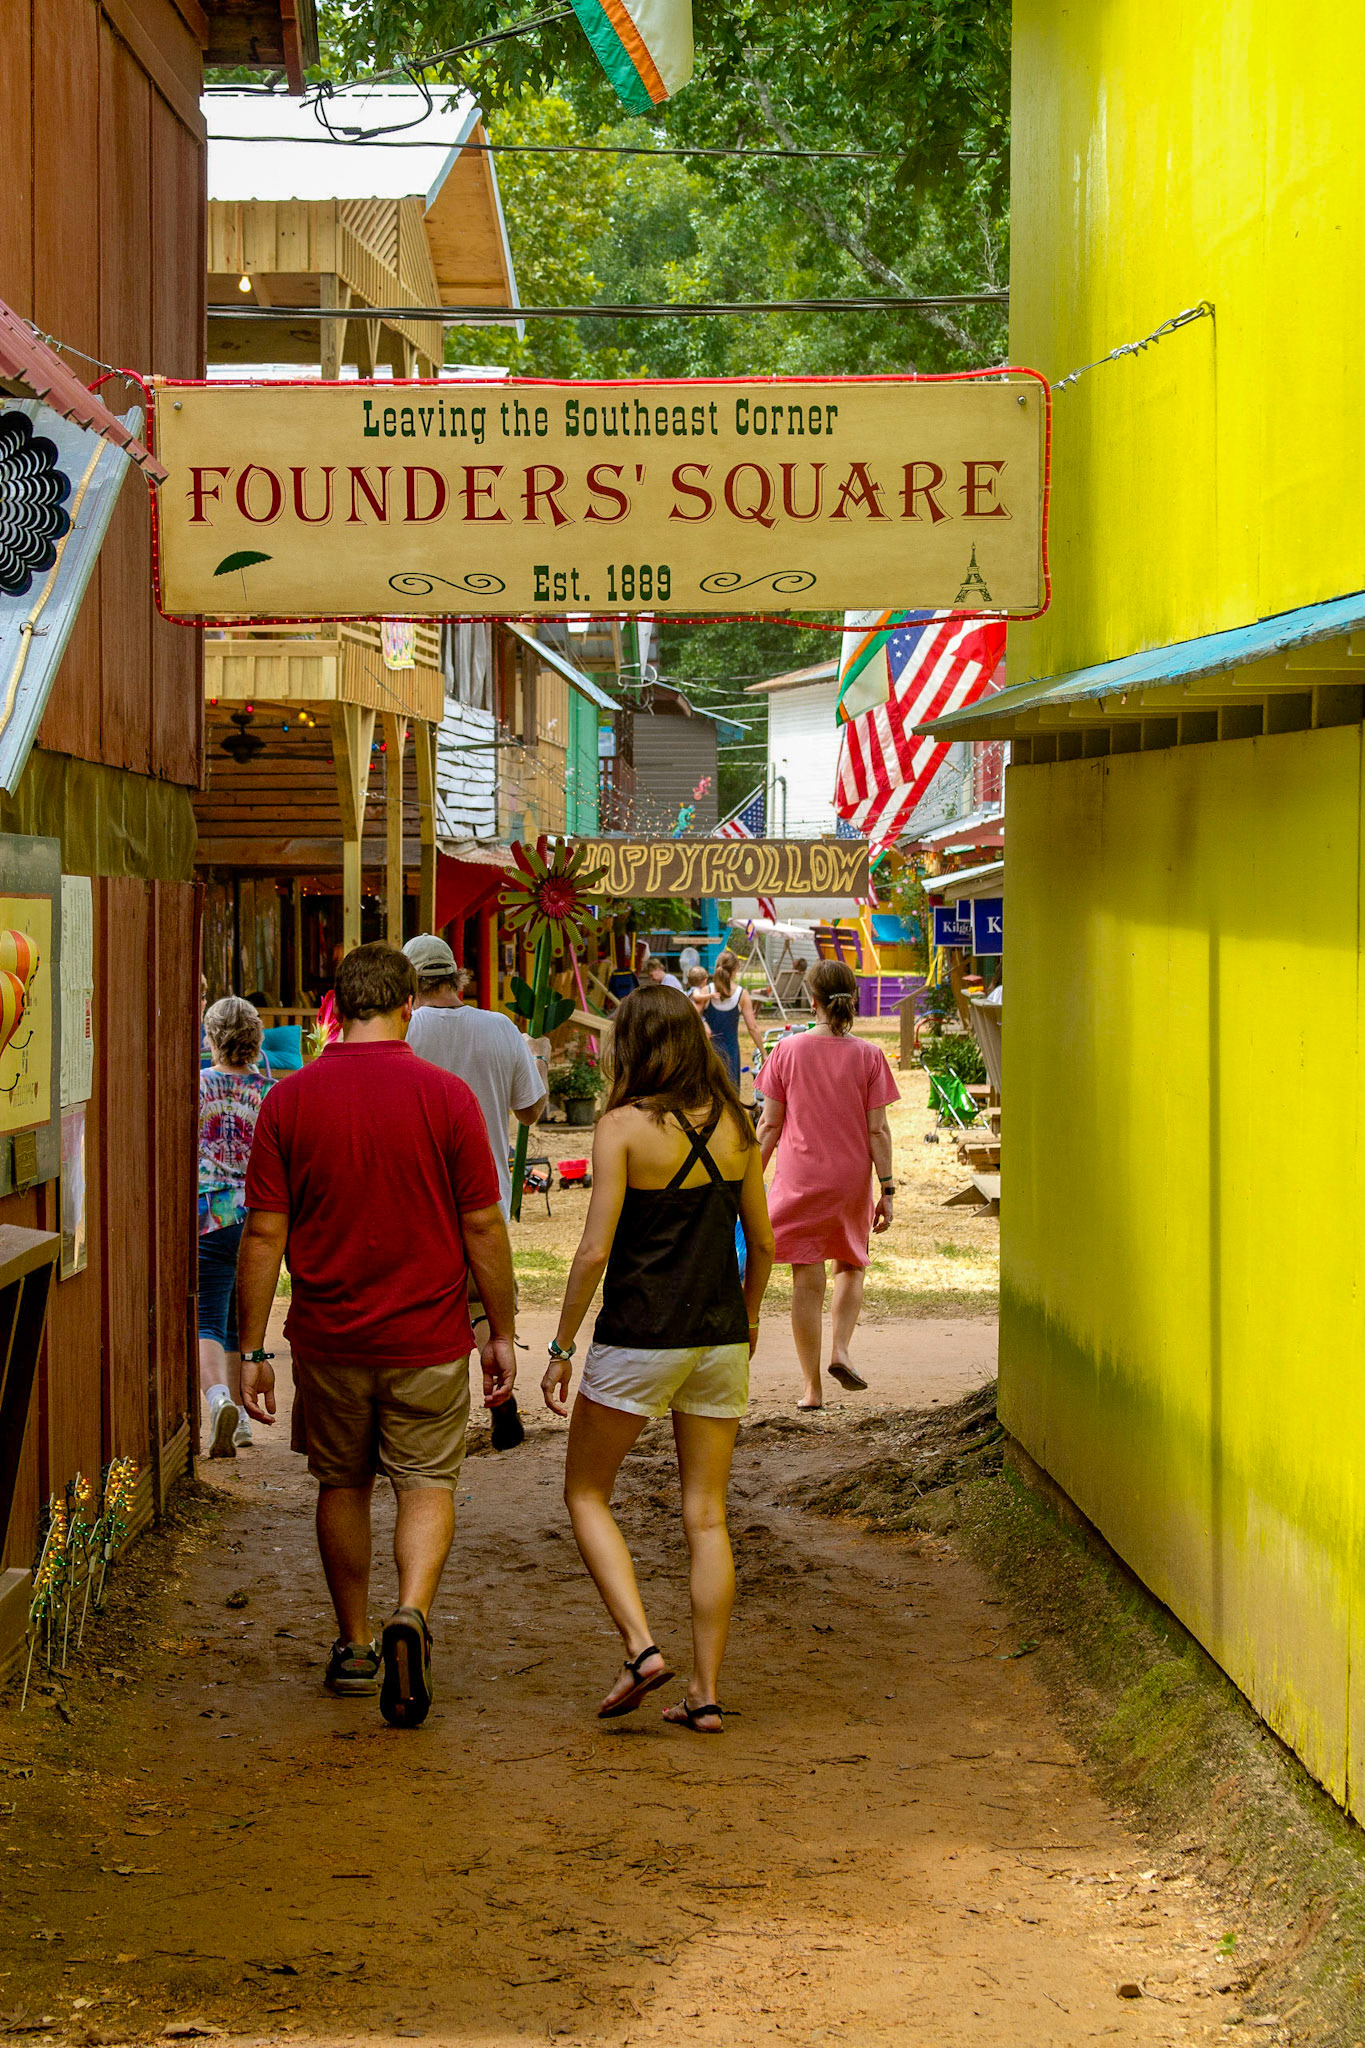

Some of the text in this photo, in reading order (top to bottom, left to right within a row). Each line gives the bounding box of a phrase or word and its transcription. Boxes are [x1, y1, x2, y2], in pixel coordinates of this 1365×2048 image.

[364, 399, 838, 444] Leaving the Southeast Corner
[186, 460, 1013, 530] FOUNDERS' SQUARE
[533, 565, 671, 602] Est. 1889
